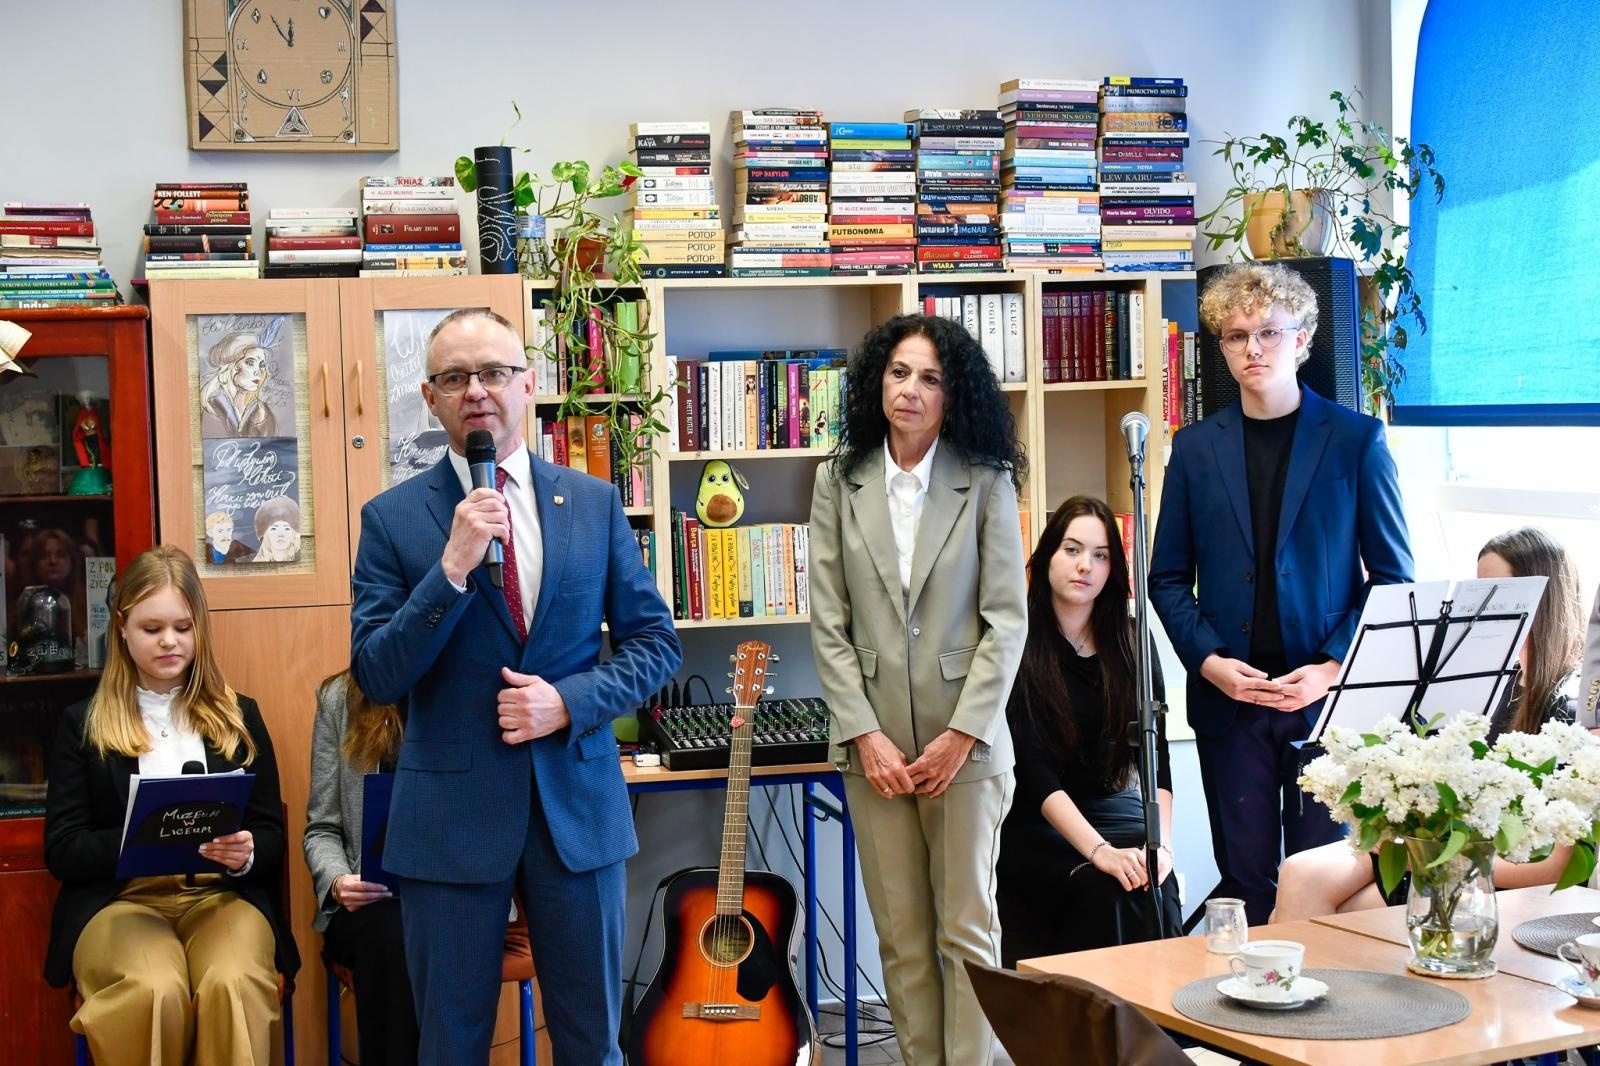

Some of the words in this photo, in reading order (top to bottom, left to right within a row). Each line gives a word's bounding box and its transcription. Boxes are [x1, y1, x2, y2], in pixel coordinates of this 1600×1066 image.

[687, 243, 716, 251] POTOP
[687, 254, 715, 262] POTOP
[1009, 302, 1017, 336] KLUCZ
[690, 527, 698, 548] Barça
[727, 542, 735, 563] ROWLING
[742, 644, 764, 652] Fender
[160, 826, 213, 838] LICEUM
